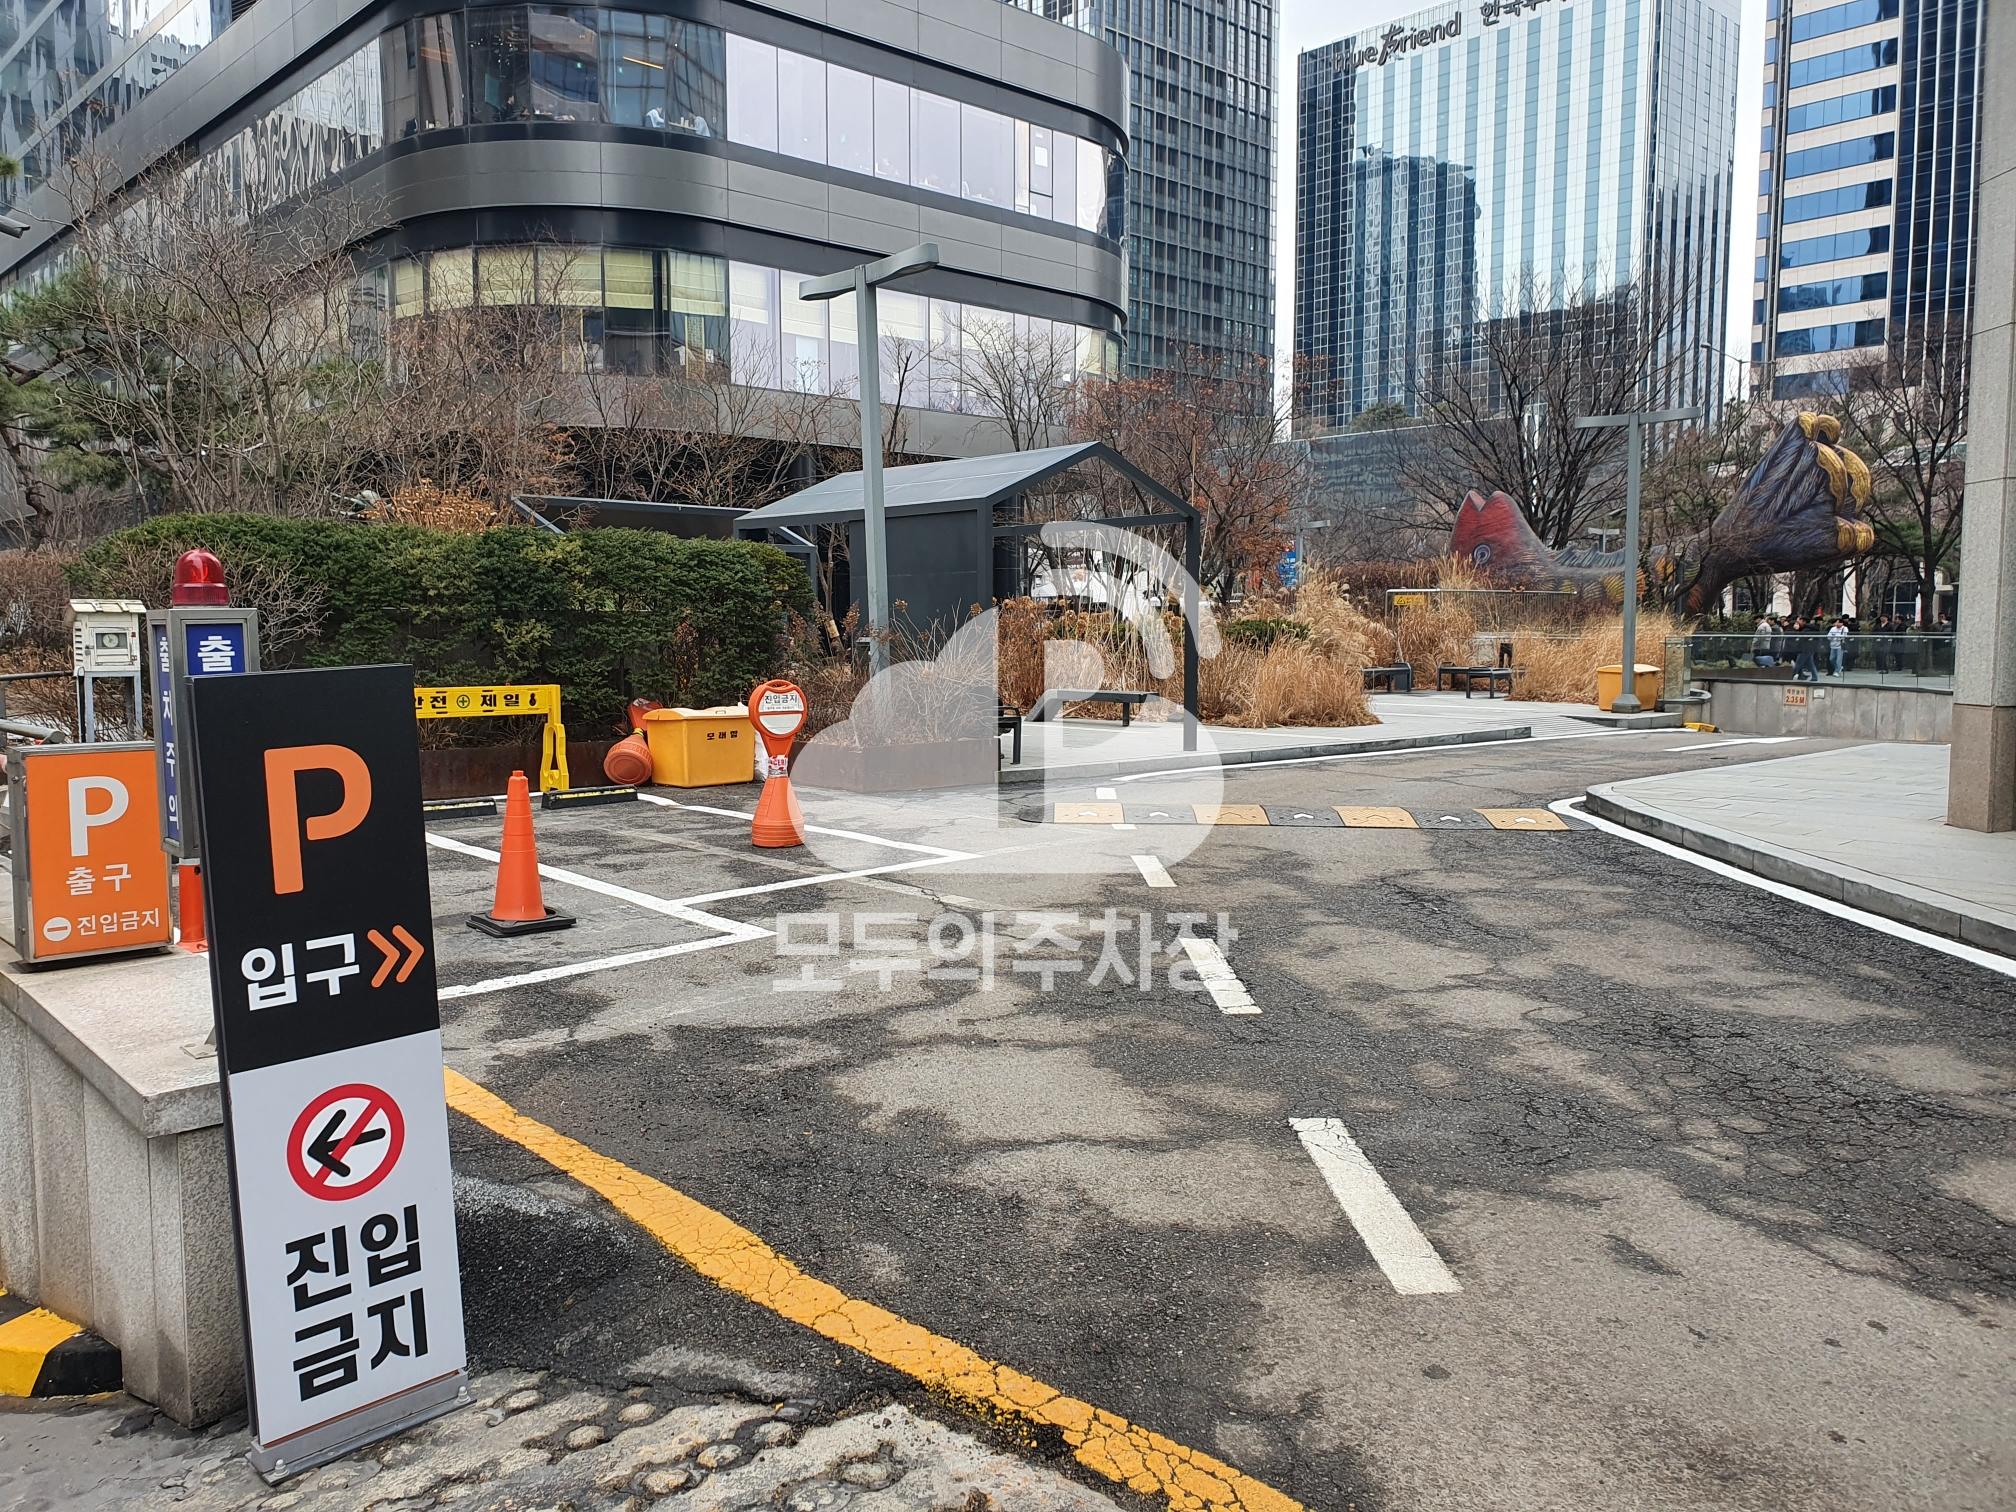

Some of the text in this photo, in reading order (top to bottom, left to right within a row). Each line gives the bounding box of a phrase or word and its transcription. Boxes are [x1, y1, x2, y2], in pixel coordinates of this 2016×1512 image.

[197, 635, 236, 672] 출
[480, 693, 519, 707] 제일
[764, 694, 797, 704] 진입금지
[68, 775, 129, 857] P
[264, 743, 372, 895] P
[65, 863, 132, 896] 출구
[76, 907, 160, 936] 진입금지
[240, 932, 360, 1011] 입구
[285, 1203, 422, 1313] 진입
[292, 1287, 429, 1402] 금지
